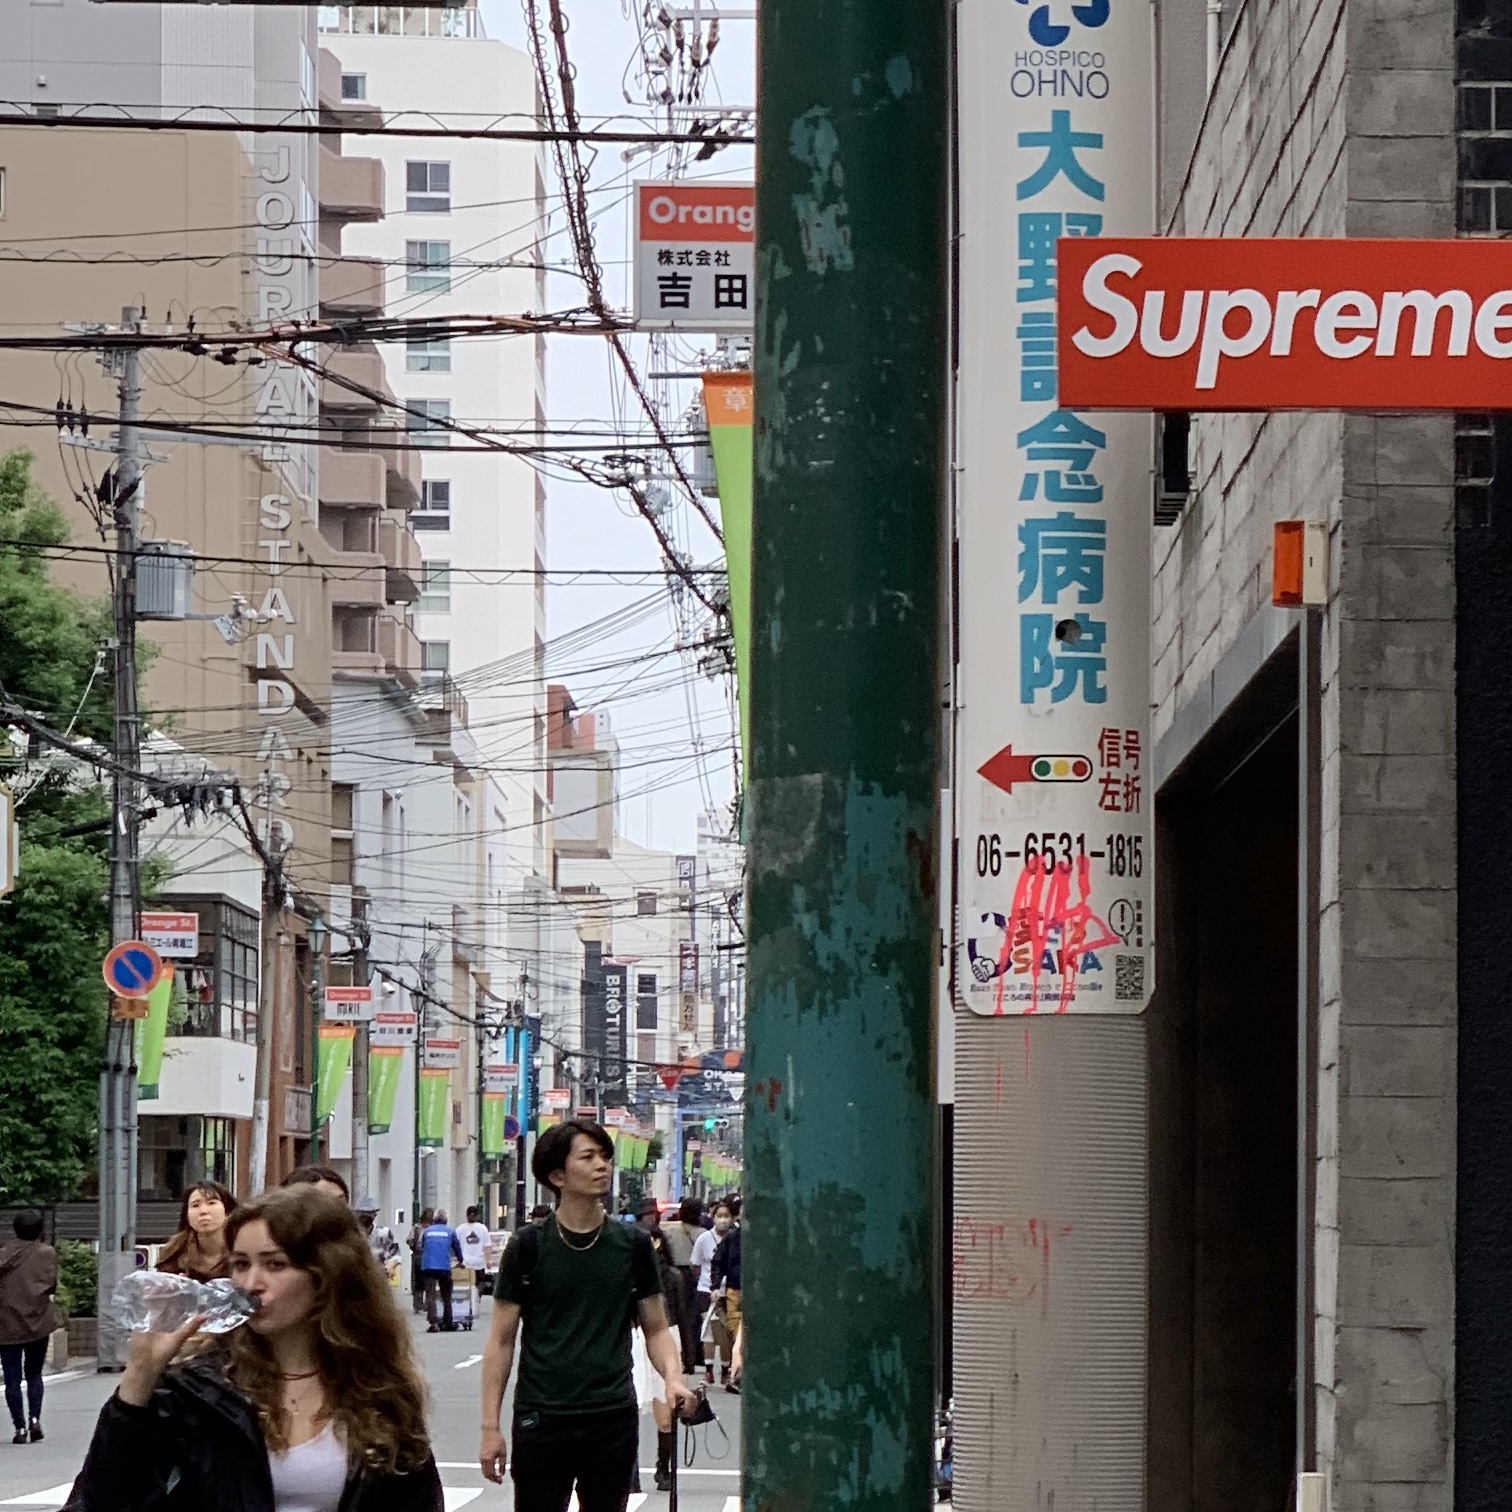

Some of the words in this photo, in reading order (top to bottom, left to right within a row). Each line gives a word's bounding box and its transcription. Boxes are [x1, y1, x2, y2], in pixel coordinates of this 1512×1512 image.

[1014, 50, 1105, 69] HOSPICO
[1010, 69, 1110, 100] OHNO
[657, 248, 731, 267] 株式会社
[657, 272, 747, 309] 吉田
[1098, 727, 1141, 770] 信号
[1098, 771, 1142, 814] 左折
[976, 832, 1143, 878] 06-6531-1815
